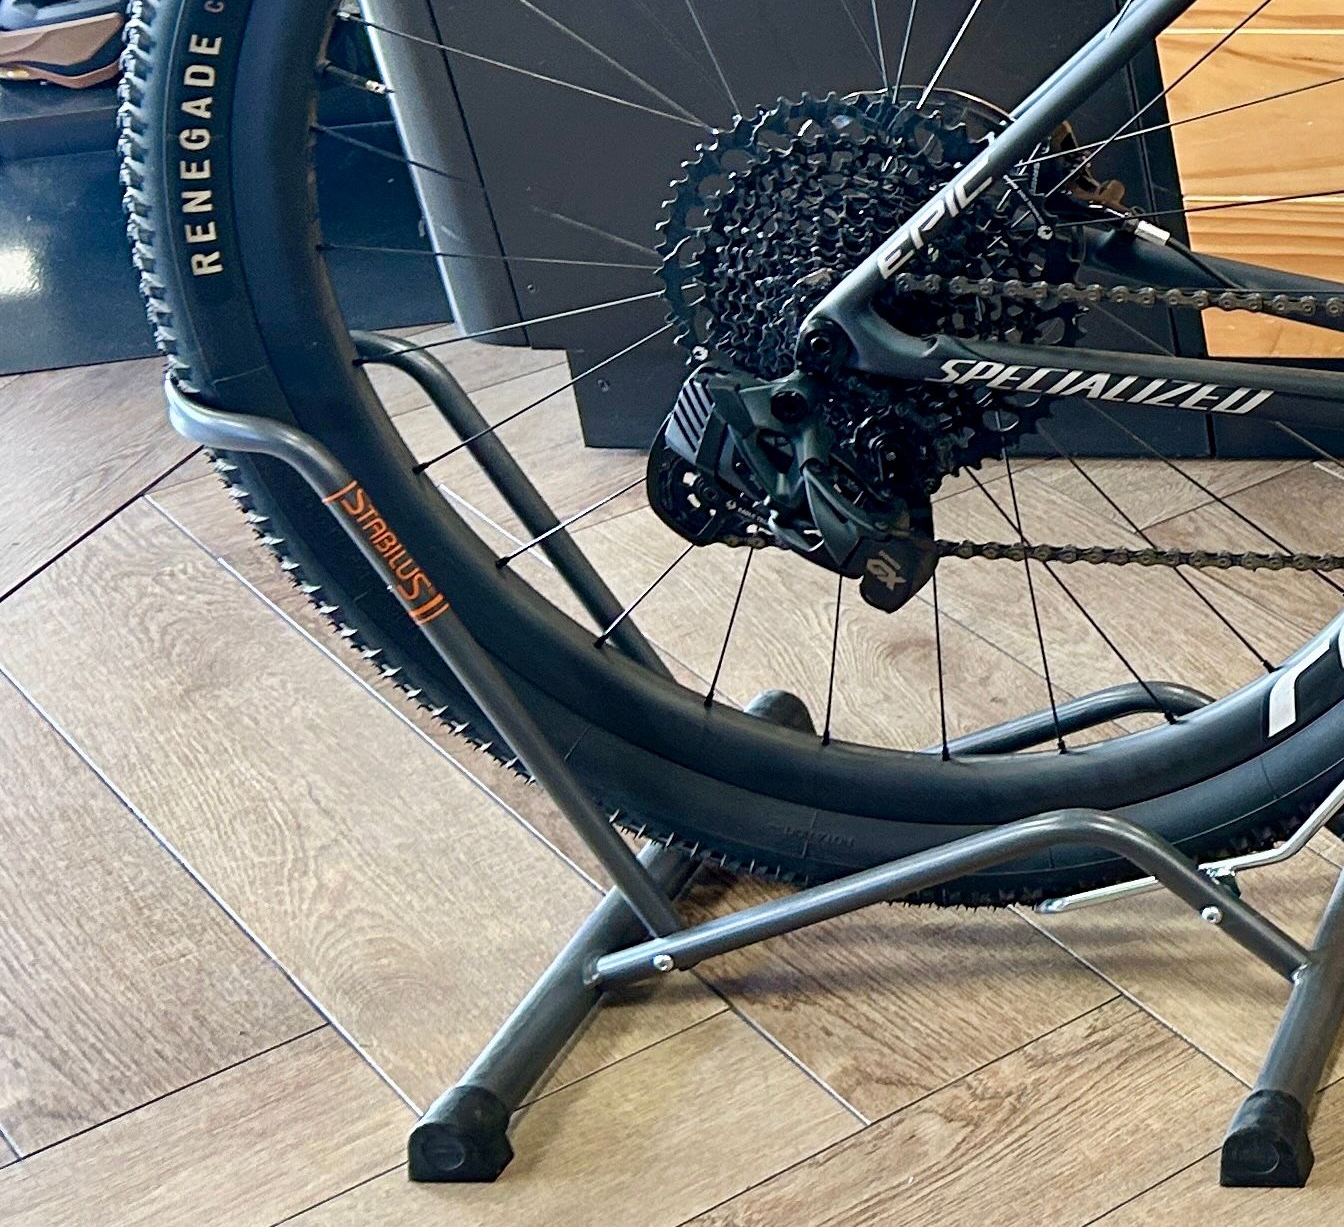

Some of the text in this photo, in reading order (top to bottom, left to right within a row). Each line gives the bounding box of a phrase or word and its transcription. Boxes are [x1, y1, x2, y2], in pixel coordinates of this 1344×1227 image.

[180, 33, 225, 277] RENEGADE
[877, 153, 995, 280] EPIC
[939, 357, 1275, 415] SPECIALIZED
[340, 486, 434, 601] STABILUS
